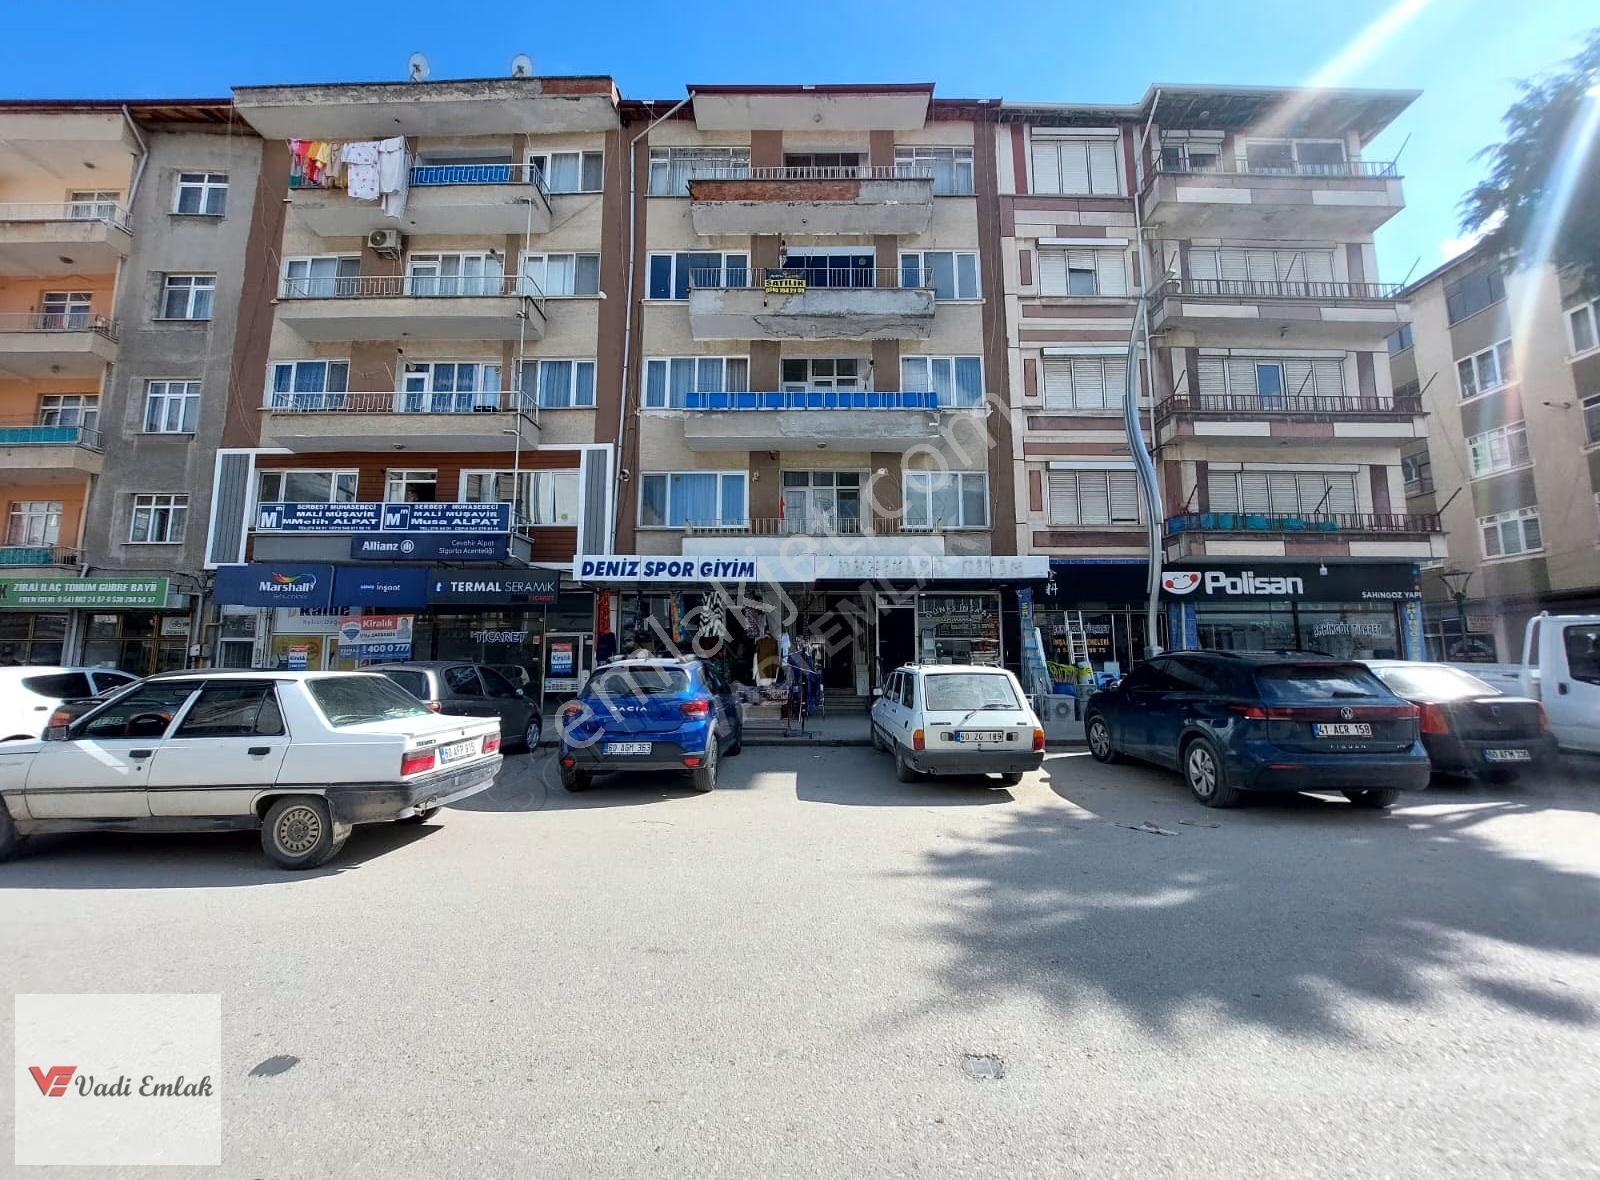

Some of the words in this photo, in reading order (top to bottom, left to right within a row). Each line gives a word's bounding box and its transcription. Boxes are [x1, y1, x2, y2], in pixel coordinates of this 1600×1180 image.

[766, 279, 804, 287] SATILIK
[325, 510, 375, 518] MÜŞAVİR
[446, 510, 498, 518] MÜŞAVİR
[362, 540, 399, 551] Allianz
[477, 540, 494, 548] Alpat
[581, 557, 640, 577] DENİZ
[643, 561, 694, 577] SPOR
[700, 558, 755, 577] GİYİM
[259, 581, 310, 592] Marshall
[450, 581, 502, 592] TERMAL
[1204, 571, 1304, 595] Polisan
[362, 618, 394, 629] Kiralık
[368, 644, 386, 653] 400
[394, 643, 410, 652] 777
[1319, 723, 1329, 736] 41
[1334, 723, 1349, 736] ACR
